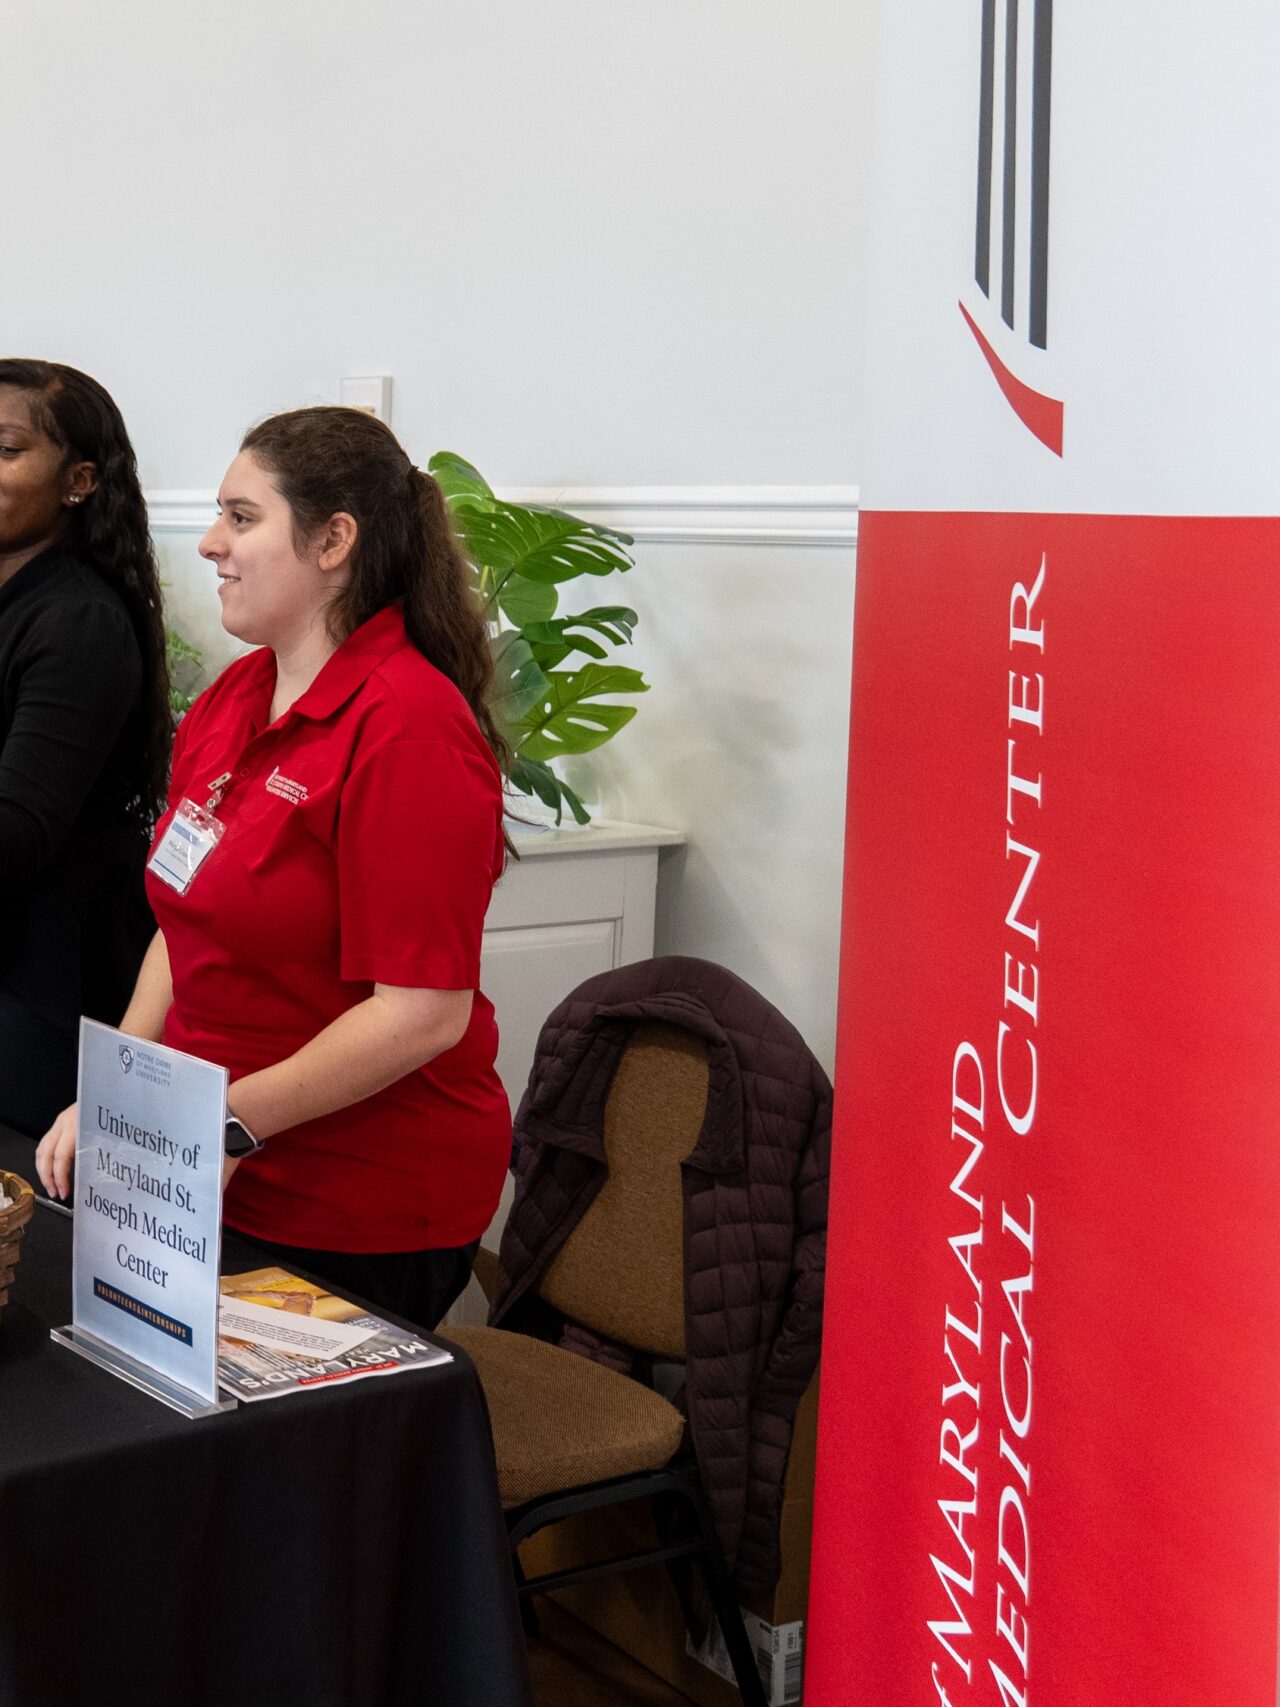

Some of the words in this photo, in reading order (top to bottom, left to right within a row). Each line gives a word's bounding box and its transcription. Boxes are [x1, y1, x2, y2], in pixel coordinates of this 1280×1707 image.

[997, 551, 1046, 1135] CENTER
[135, 1069, 170, 1087] UNIVERSITY
[97, 1105, 179, 1166] University
[182, 1143, 201, 1170] of
[96, 1147, 171, 1203] Maryland
[175, 1183, 196, 1214] St.
[84, 1186, 138, 1230] Joseph
[141, 1211, 207, 1264] Medical
[116, 1243, 169, 1288] Center
[238, 1341, 429, 1390] MARYLAND'S
[926, 1041, 985, 1684] MARYLAND
